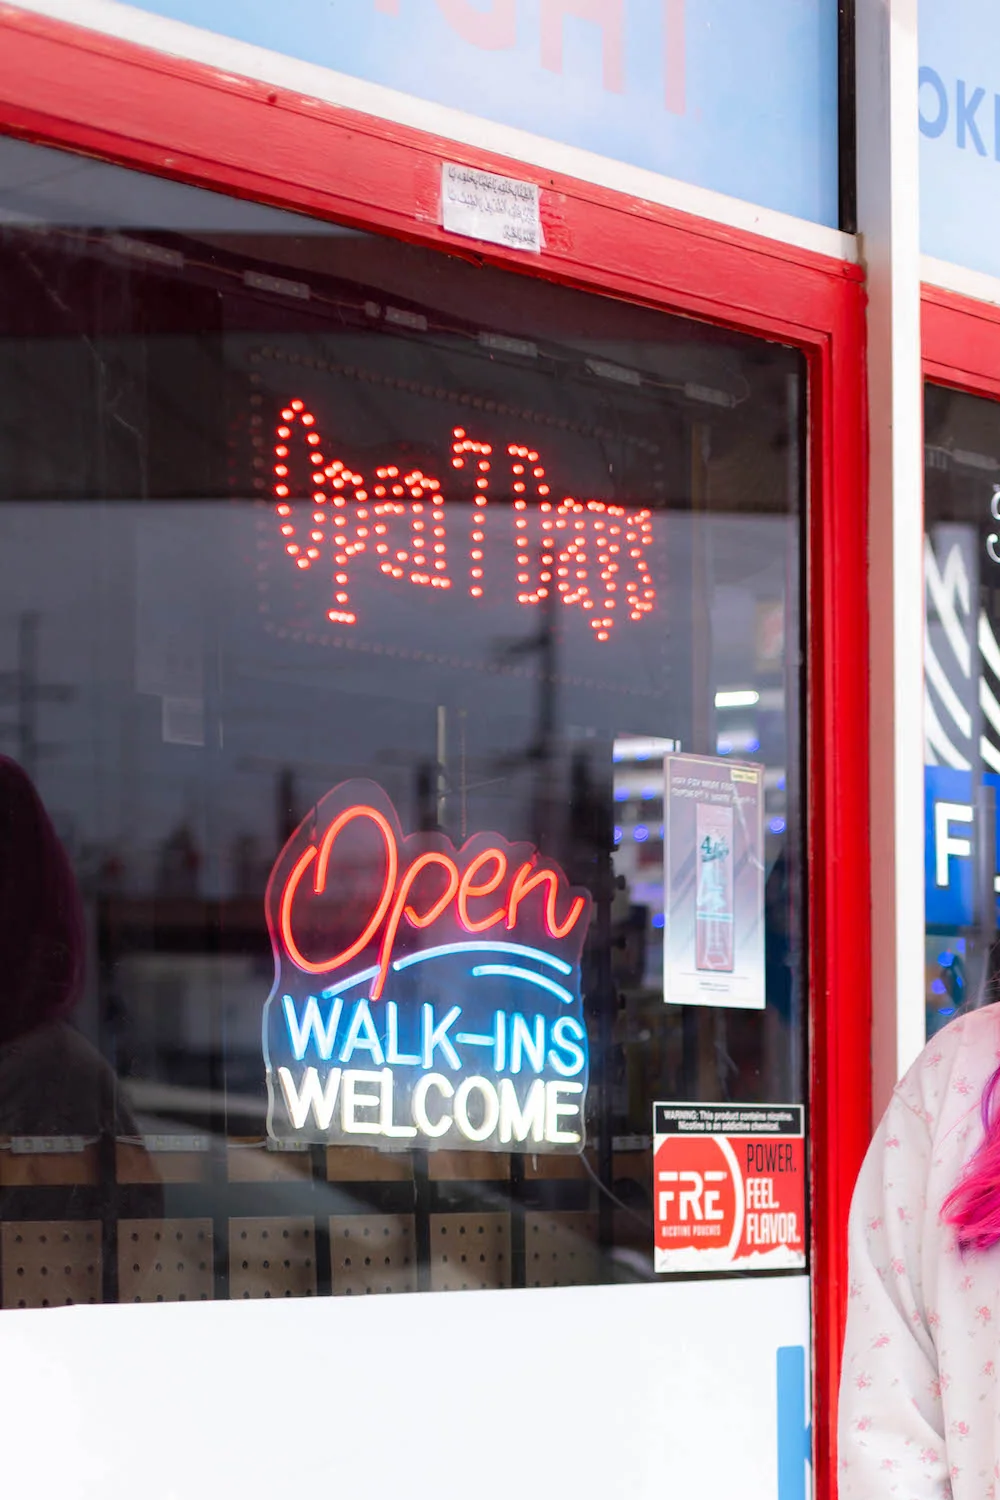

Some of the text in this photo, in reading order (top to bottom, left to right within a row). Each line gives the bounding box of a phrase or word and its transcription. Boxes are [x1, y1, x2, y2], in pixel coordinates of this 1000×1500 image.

[274, 398, 656, 641] Open 7 Days
[281, 804, 585, 1001] Open
[281, 994, 585, 1077] WALK-INS
[279, 1066, 583, 1143] WELCOME
[663, 1110, 699, 1120] WARNING:
[678, 1121, 704, 1131] Nicotine
[746, 1143, 797, 1173] POWER.
[658, 1171, 725, 1221] FRE
[746, 1178, 780, 1209] FEEL.
[746, 1212, 801, 1245] FLAVOR.
